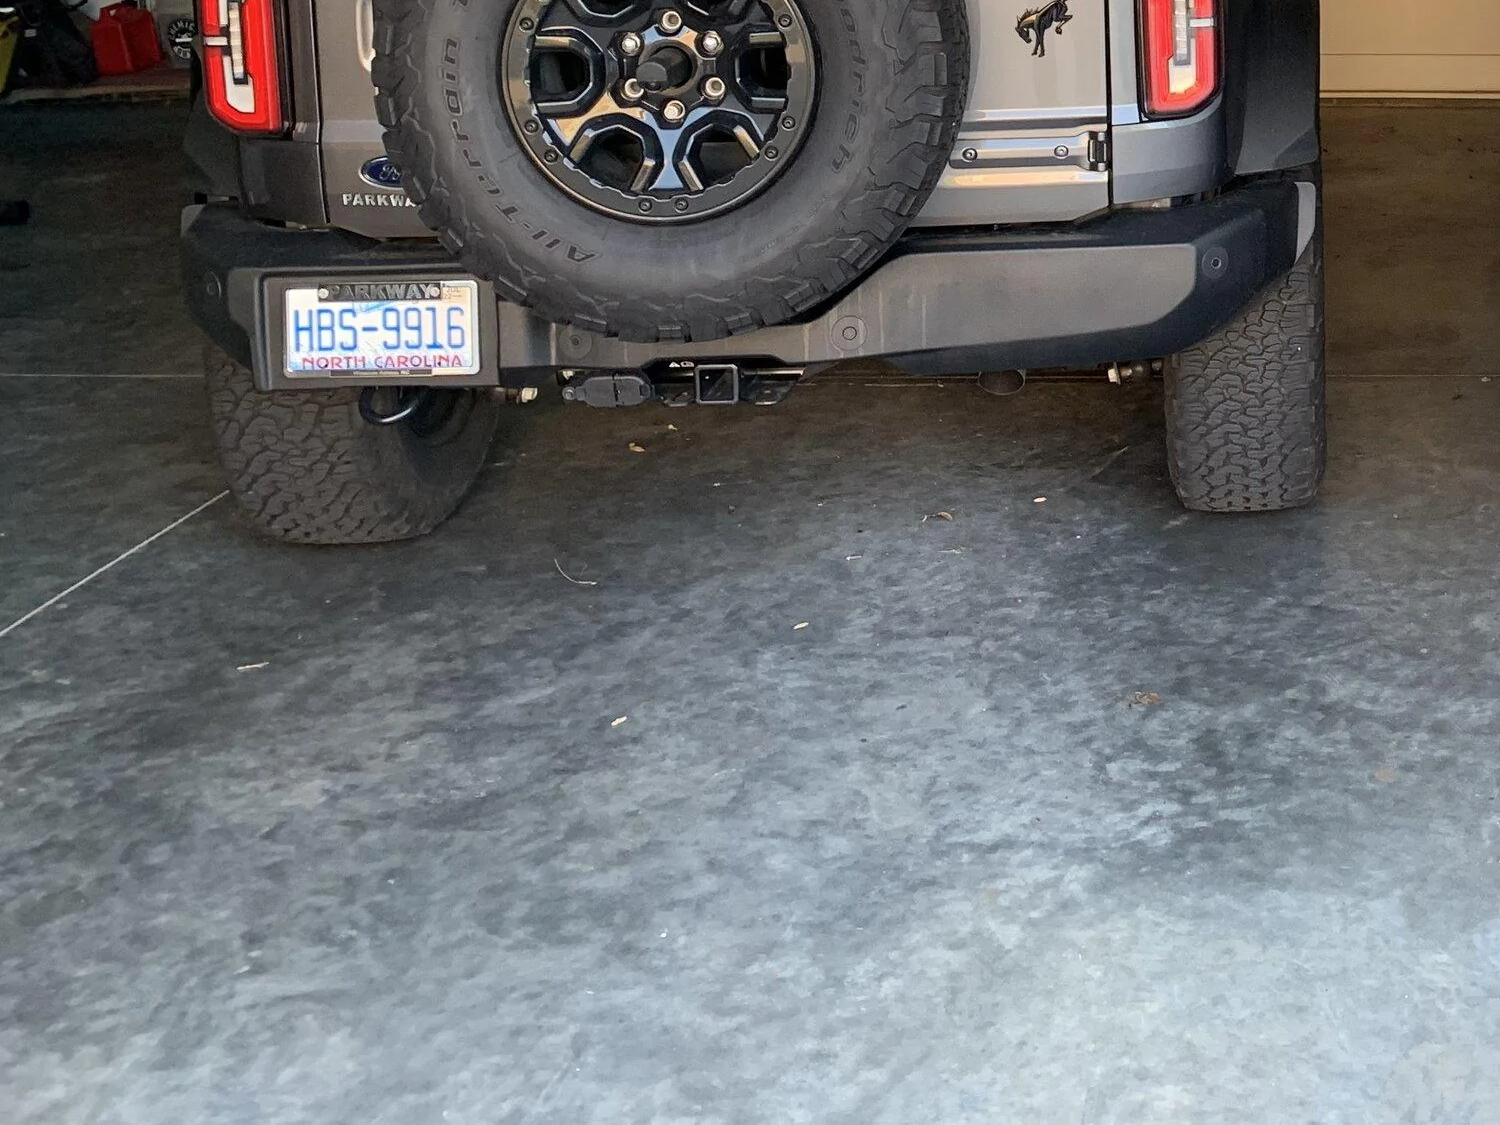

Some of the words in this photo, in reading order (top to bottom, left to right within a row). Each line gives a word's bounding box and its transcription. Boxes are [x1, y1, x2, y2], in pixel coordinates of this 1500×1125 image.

[342, 193, 421, 207] PARKWA
[327, 283, 432, 301] PARKWAY
[293, 306, 466, 352] HBS-9916
[302, 356, 367, 370] NORTH
[374, 354, 463, 368] CAROLINA
